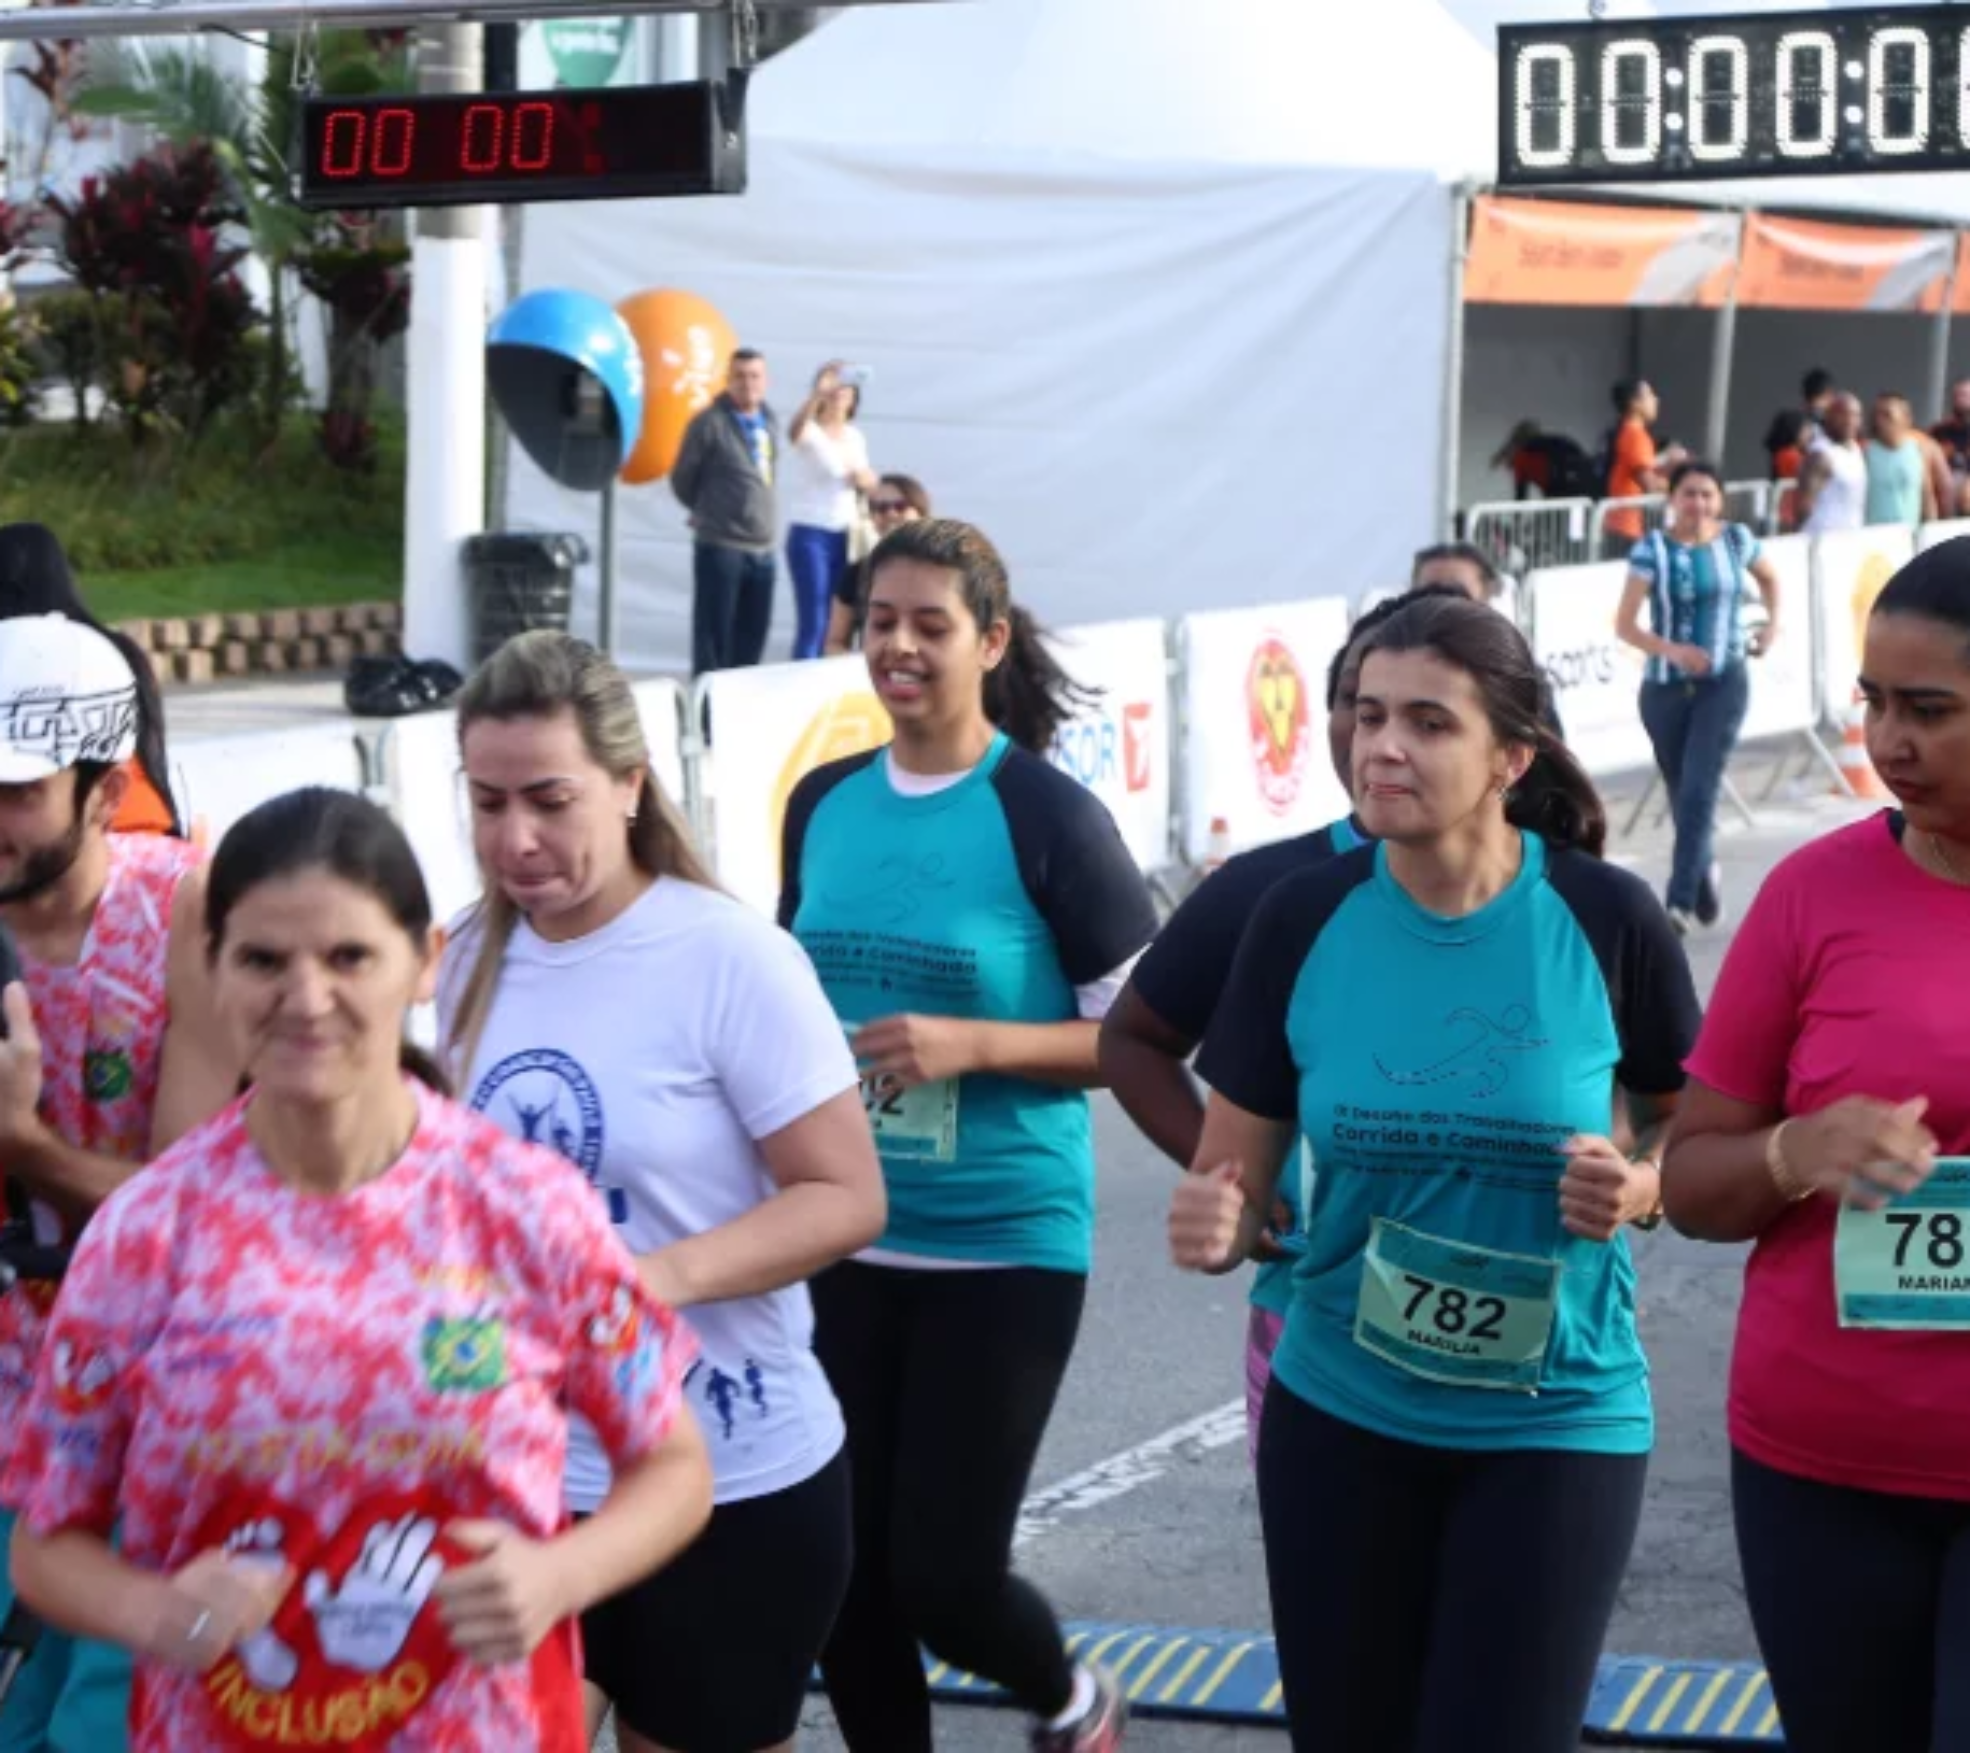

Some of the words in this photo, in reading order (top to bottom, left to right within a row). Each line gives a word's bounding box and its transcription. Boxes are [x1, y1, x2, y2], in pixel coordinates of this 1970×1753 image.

[1515, 26, 1970, 167] 00:00:0
[1333, 1123, 1418, 1145] Corrida
[1426, 1131, 1439, 1147] e
[1404, 1274, 1507, 1341] 782
